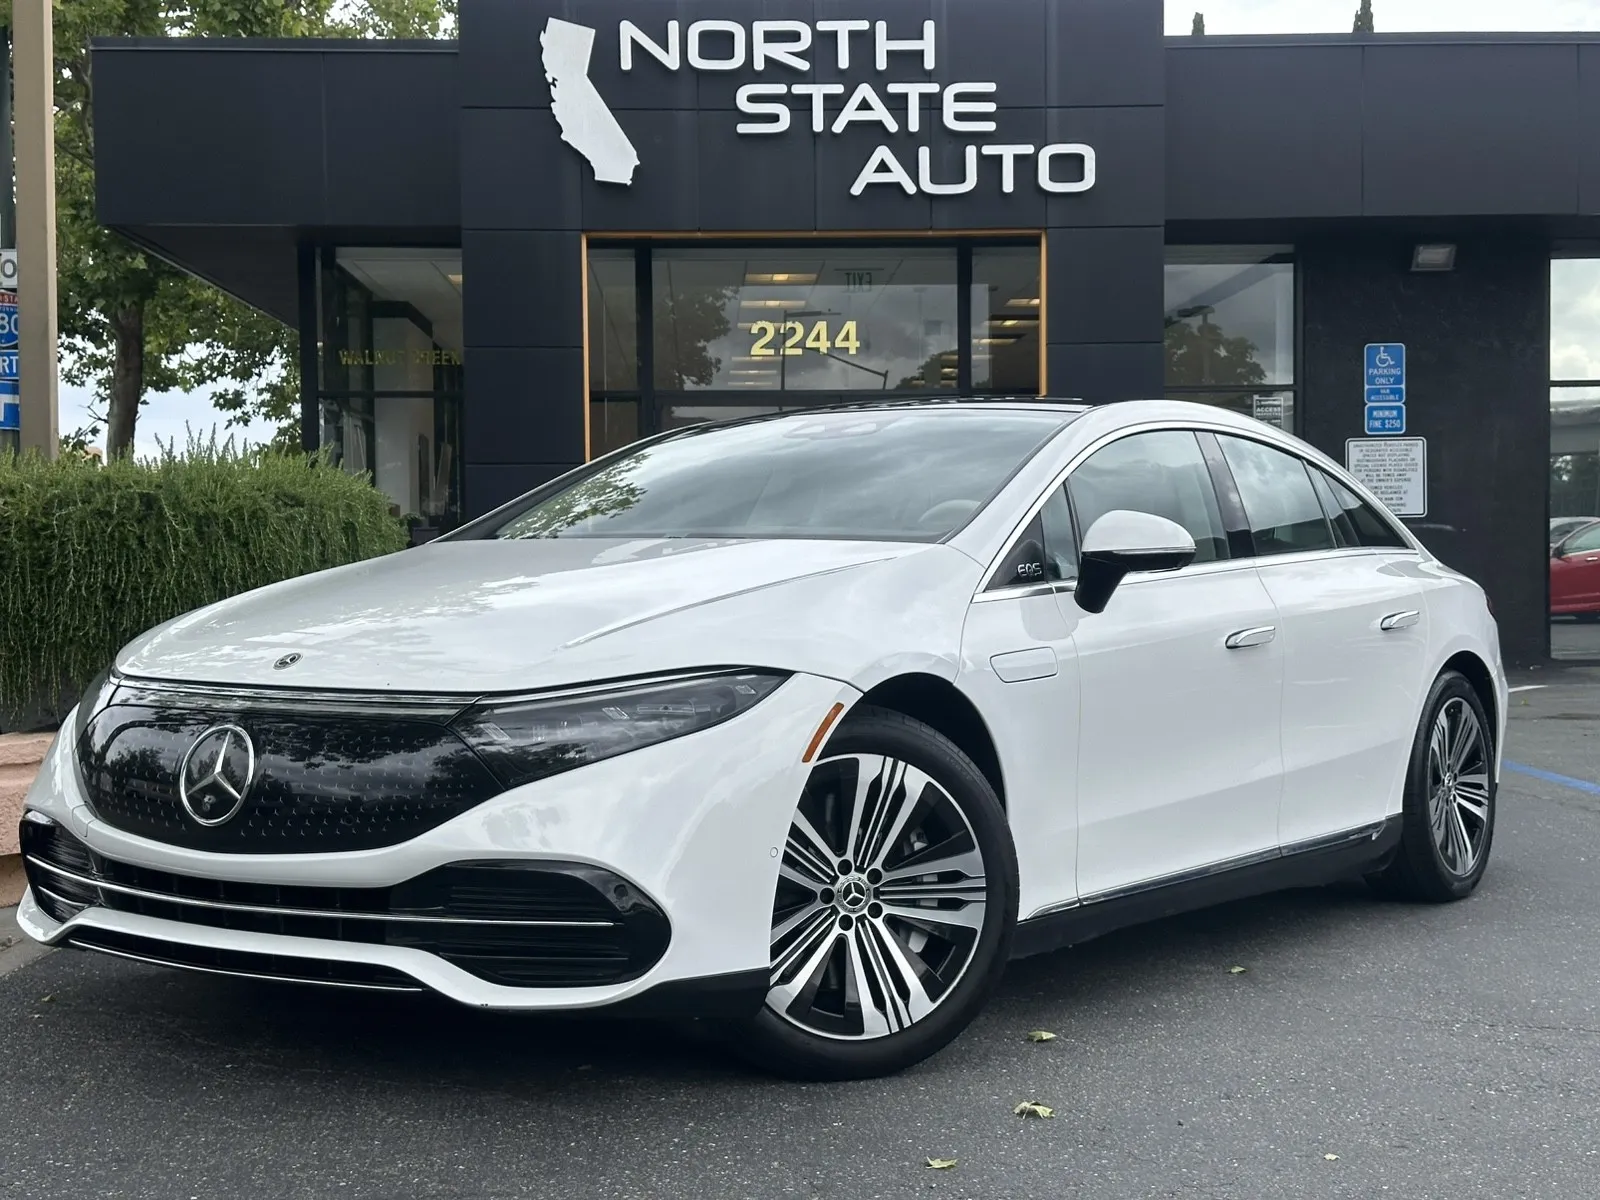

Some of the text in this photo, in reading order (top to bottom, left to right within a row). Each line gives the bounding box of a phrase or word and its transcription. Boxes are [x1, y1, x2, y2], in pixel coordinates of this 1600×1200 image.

[620, 20, 935, 71] NORTH
[736, 82, 997, 133] STATE
[850, 144, 1096, 196] AUTO
[750, 320, 861, 356] 2244
[1375, 377, 1395, 385] ONLY
[1369, 420, 1401, 428] FINE $250
[1372, 410, 1398, 418] MINIMUM
